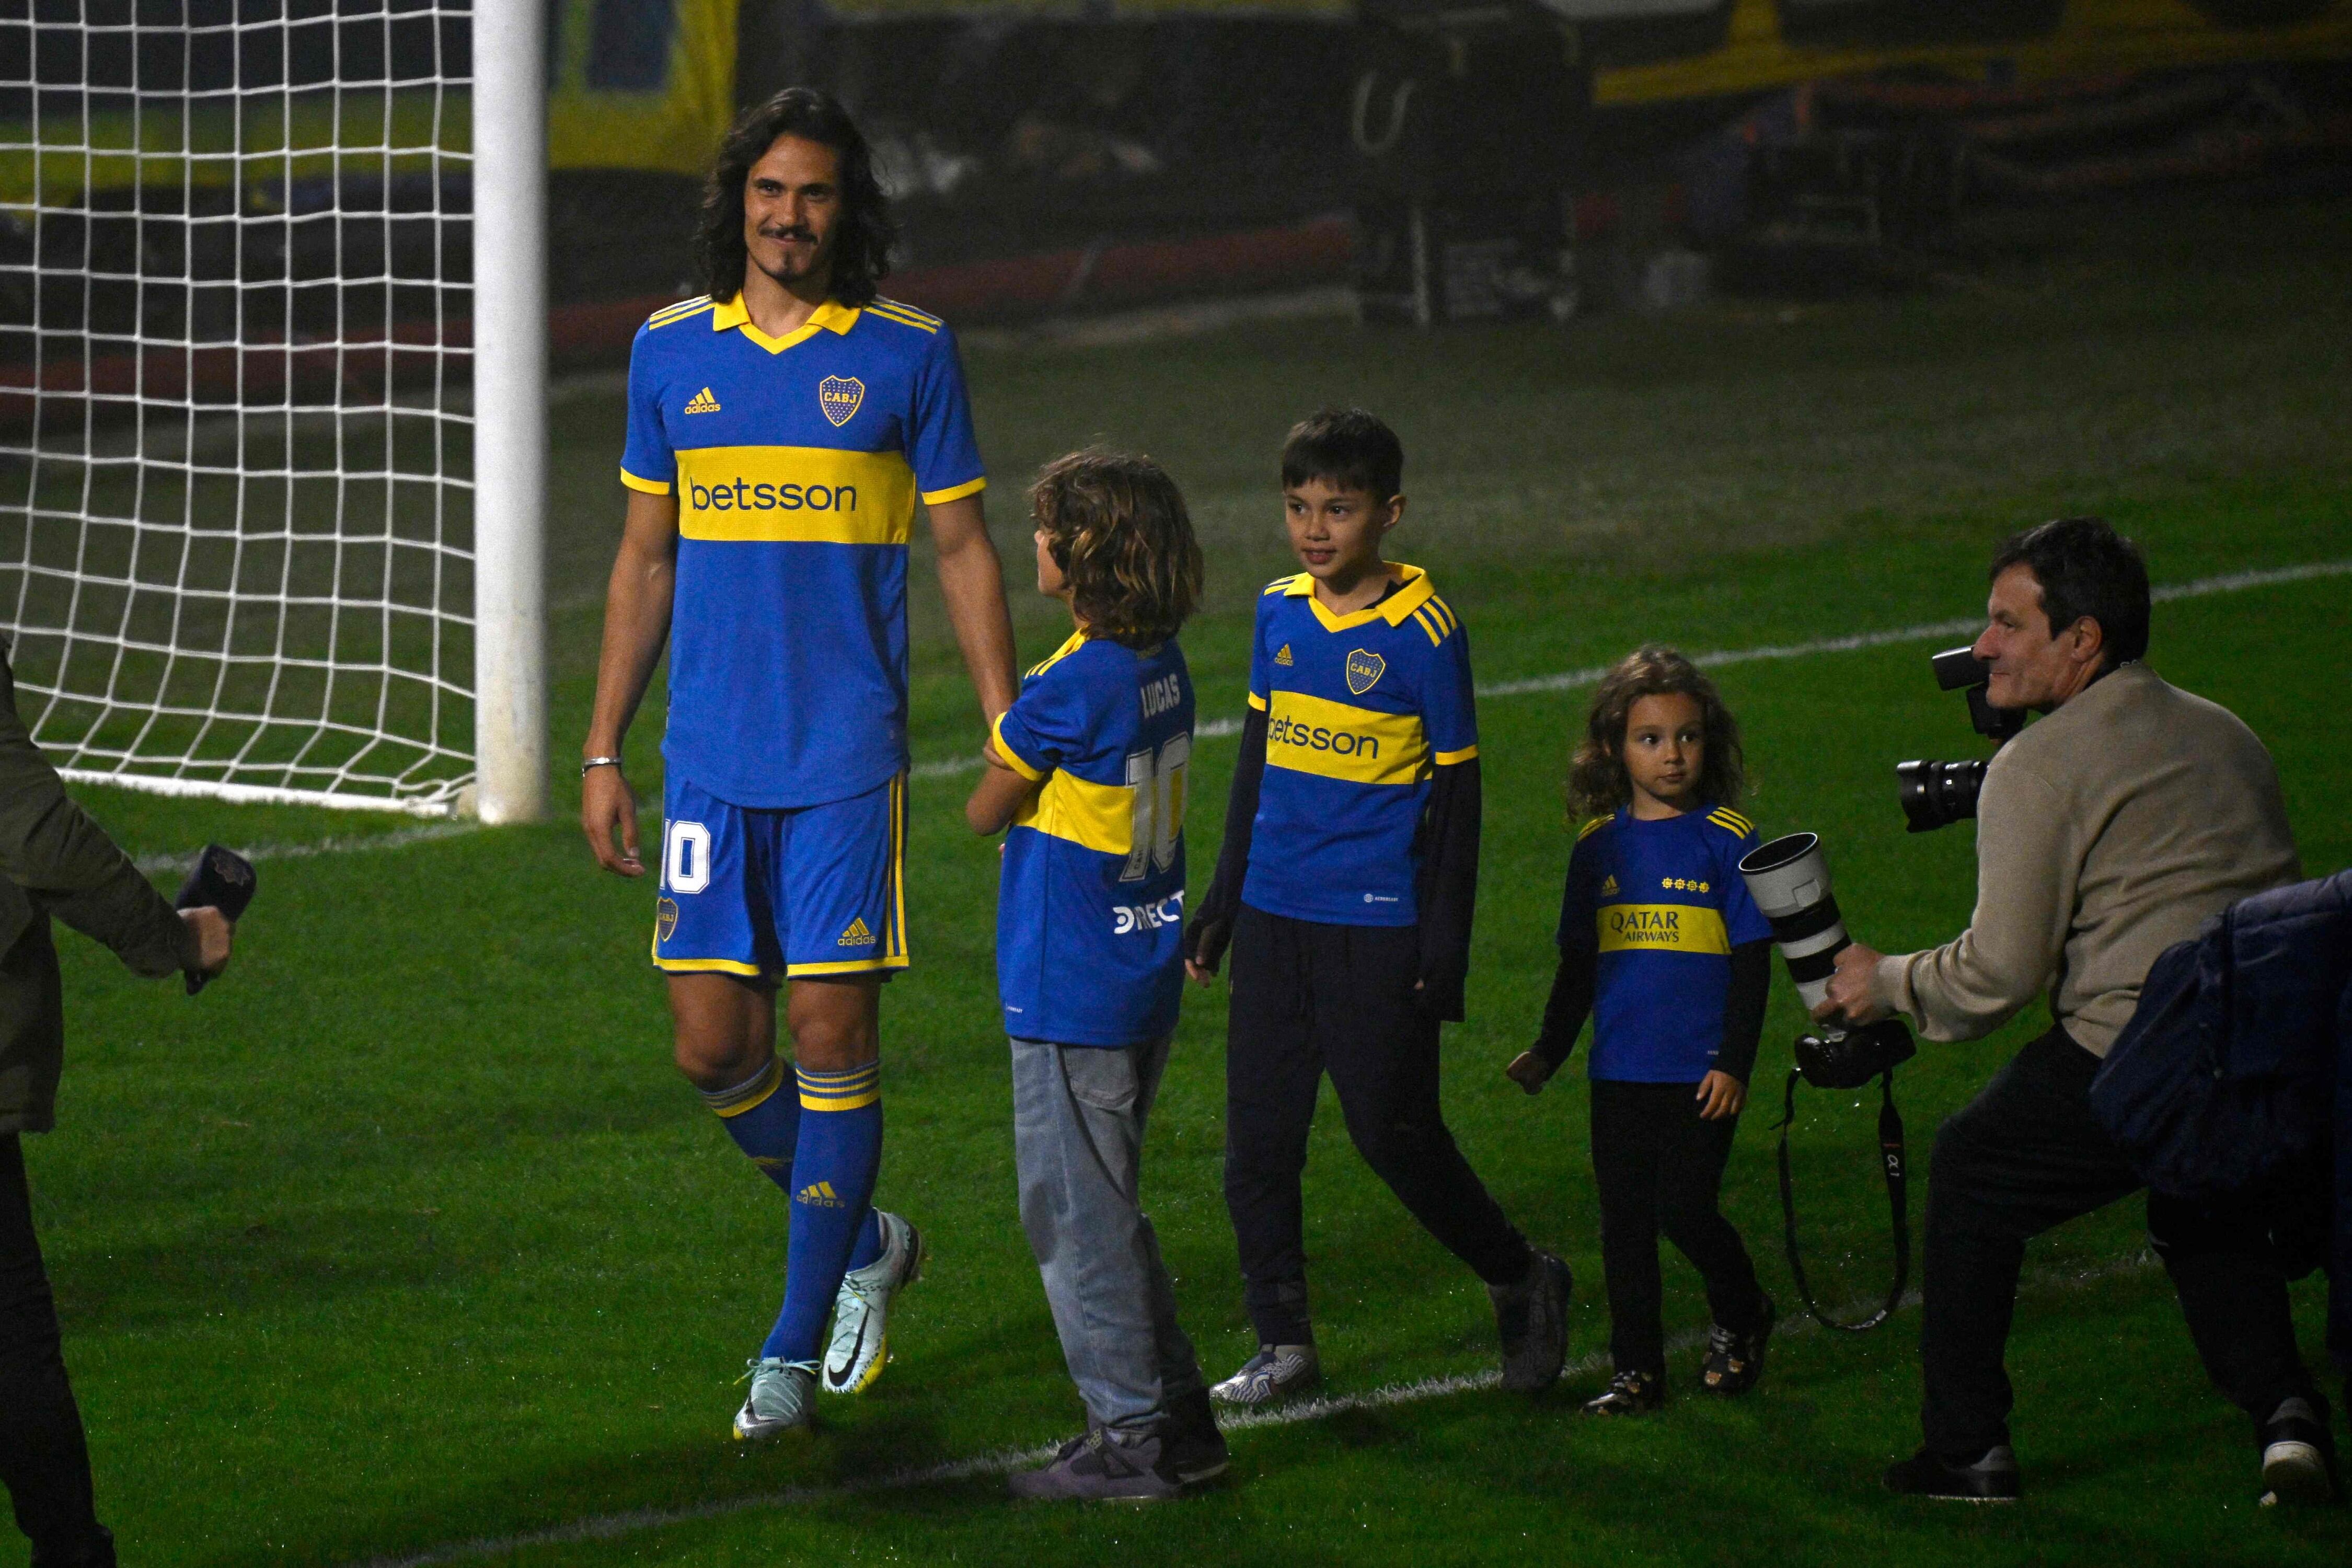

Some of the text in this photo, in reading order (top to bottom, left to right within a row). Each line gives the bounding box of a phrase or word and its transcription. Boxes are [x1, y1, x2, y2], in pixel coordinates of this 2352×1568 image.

[824, 391, 858, 403] CABJ
[685, 402, 721, 414] adidas
[689, 476, 857, 512] betsson
[1350, 663, 1377, 678] CABJ
[1140, 673, 1181, 719] LUCAS
[1119, 731, 1191, 882] 10
[1610, 911, 1679, 933] QATAR
[837, 934, 877, 947] adidas
[1624, 931, 1680, 942] AIRWAYS
[796, 1193, 846, 1208] adidas
